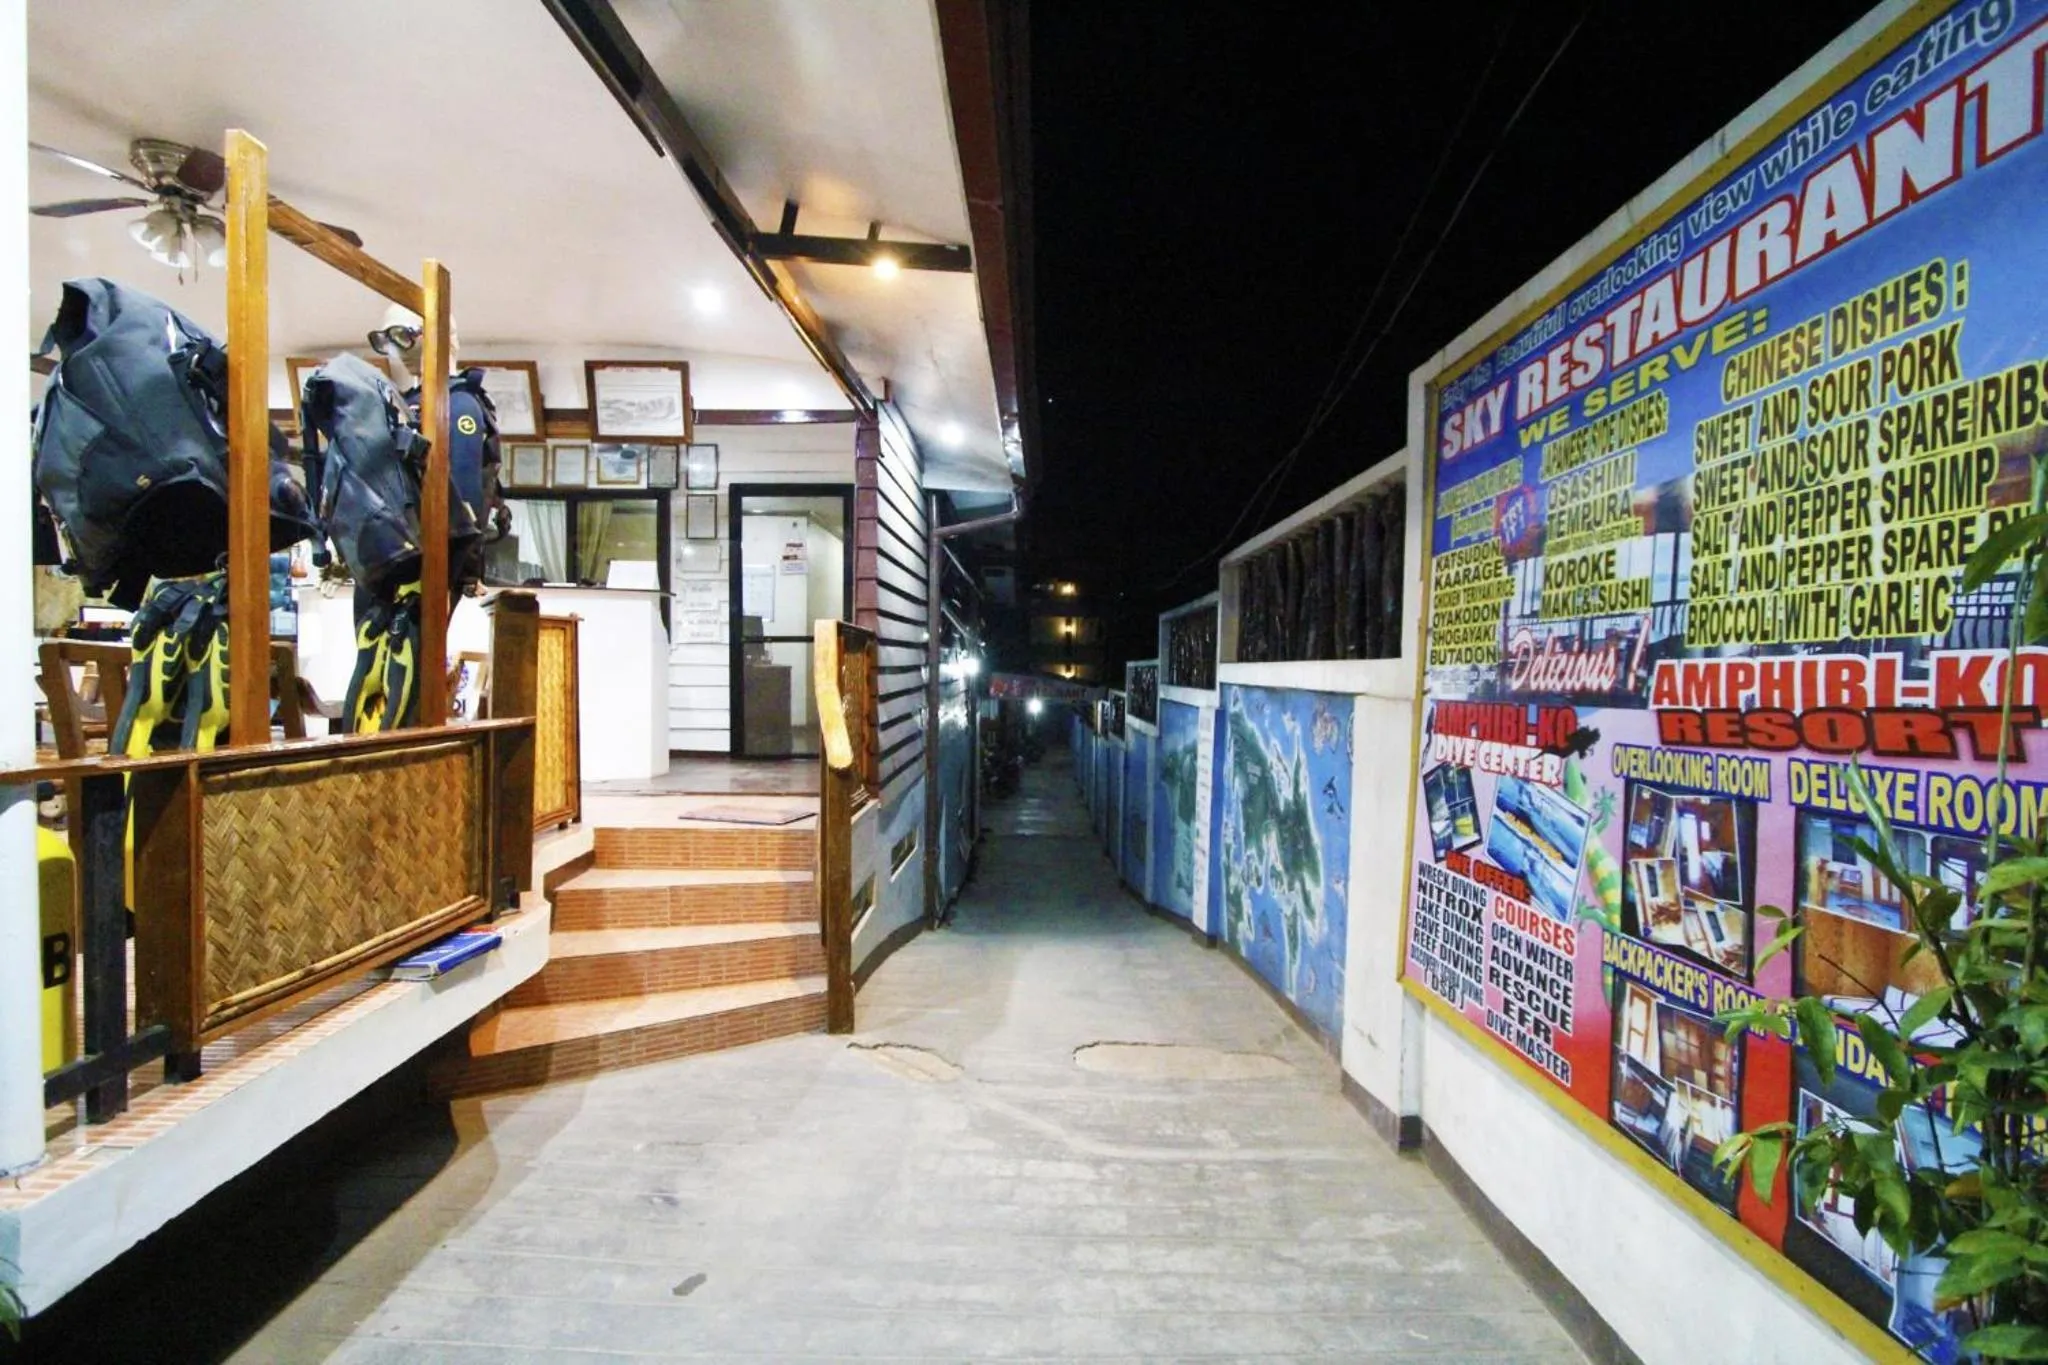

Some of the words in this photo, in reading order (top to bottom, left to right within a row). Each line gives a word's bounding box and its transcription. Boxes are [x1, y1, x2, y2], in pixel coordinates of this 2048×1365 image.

[1569, 222, 1682, 324] overlooking
[1692, 176, 1753, 238] view
[1760, 105, 1857, 186] while
[1866, 0, 2014, 112] eating
[1443, 379, 1510, 460] SKY
[1515, 14, 2048, 421] RESTAURANT
[1518, 405, 1570, 448] WE
[1583, 308, 1768, 417] SERVE:
[1724, 316, 1824, 402] CHINESE
[1695, 407, 1754, 466] SWEET
[1758, 387, 1800, 447] AND
[1806, 359, 1873, 428] SOUR
[1880, 322, 1961, 404] PORK
[1693, 457, 1751, 512] SWEET
[1757, 441, 1800, 496] AND
[1804, 417, 1871, 482] SOUR
[1878, 386, 1971, 464] SPARE
[1547, 491, 1632, 543] TEMPURA
[1692, 511, 1733, 560] SALT
[1738, 501, 1777, 551] AND
[1784, 478, 1872, 542] PEPPER
[1880, 448, 1996, 523] SHRIMP
[1434, 561, 1502, 591] KAARAGE
[1435, 541, 1501, 571] KATSUDON
[1543, 550, 1616, 589] KOROKE
[1689, 557, 1732, 599] SALT
[1737, 550, 1777, 595] AND
[1784, 534, 1873, 588] PEPPER
[1881, 516, 1977, 576] SPARE
[1433, 602, 1500, 628] OYAKODON
[1542, 588, 1577, 618] MAKI
[1599, 577, 1651, 612] SUSHI
[1687, 596, 1776, 645] BROCCOLI
[1785, 588, 1841, 640] WITH
[1850, 576, 1951, 636] GARLIC
[1430, 645, 1497, 666] BUTADON
[1432, 625, 1497, 648] SHOGAYAKI
[1511, 627, 1616, 691] Delicious
[1436, 735, 1475, 766] DIVE
[1479, 741, 1562, 785] CENTER
[1657, 706, 2037, 762] RESORT
[1613, 745, 1713, 791] OVERLOOKING
[1718, 758, 1770, 799] ROOM
[1418, 860, 1450, 884] WRECK
[1452, 873, 1487, 907] DIVING
[1446, 851, 1471, 876] WE
[1416, 894, 1440, 920] LAKE
[1442, 906, 1484, 943] DIVING
[1417, 878, 1483, 924] NITROX
[1494, 896, 1576, 957] COURSES
[1414, 928, 1437, 955] REEF
[1440, 941, 1483, 983] DIVING
[1415, 911, 1440, 938] CAVE
[1442, 925, 1484, 964] DIVING
[1491, 922, 1522, 951] OPEN
[1526, 938, 1574, 983] WATER
[1490, 946, 1573, 1009] ADVANCE
[1603, 931, 1709, 1009] BACKPACKER'S
[1489, 966, 1573, 1034] RESCUE
[1503, 998, 1552, 1044] EFR
[1486, 1009, 1513, 1041] DIVE
[1516, 1027, 1571, 1085] MASTER
